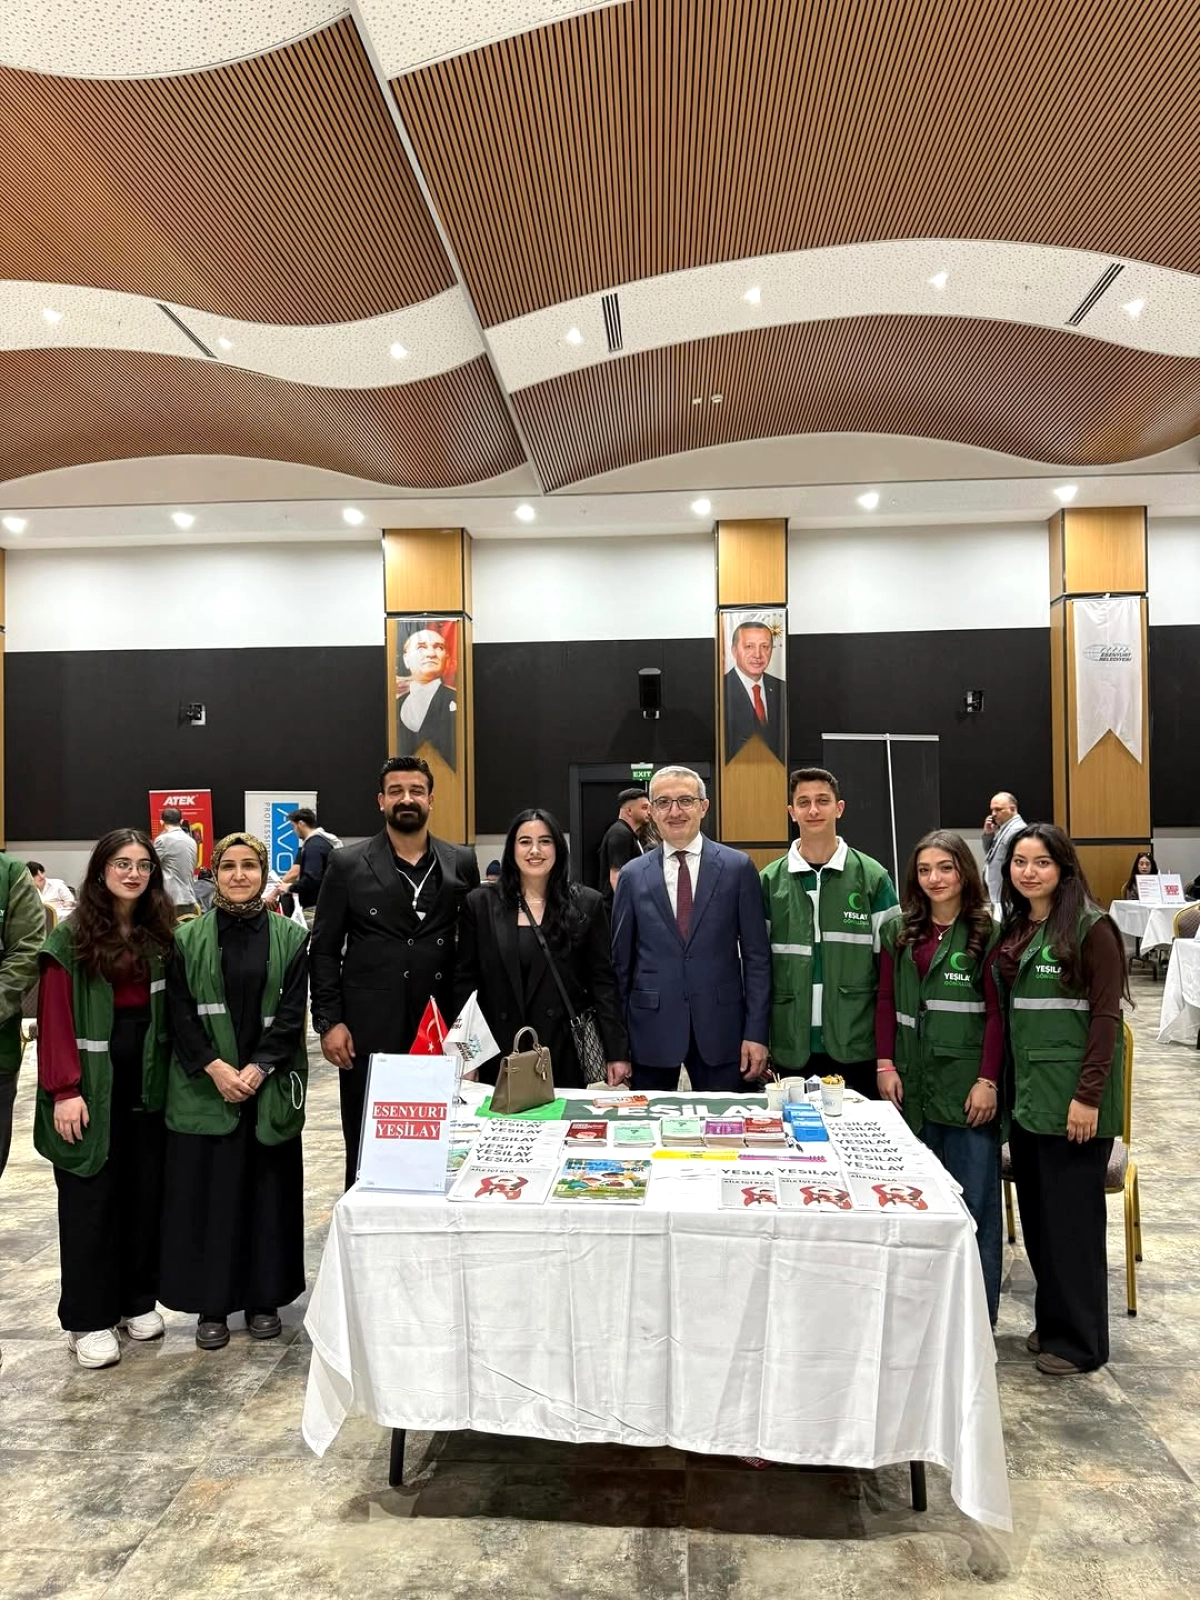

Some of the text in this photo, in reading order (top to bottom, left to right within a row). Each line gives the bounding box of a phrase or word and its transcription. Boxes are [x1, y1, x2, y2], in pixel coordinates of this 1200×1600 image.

[163, 795, 196, 806] ATEK
[373, 1105, 447, 1118] ESENYURT
[377, 1121, 440, 1139] YEŞİLAY
